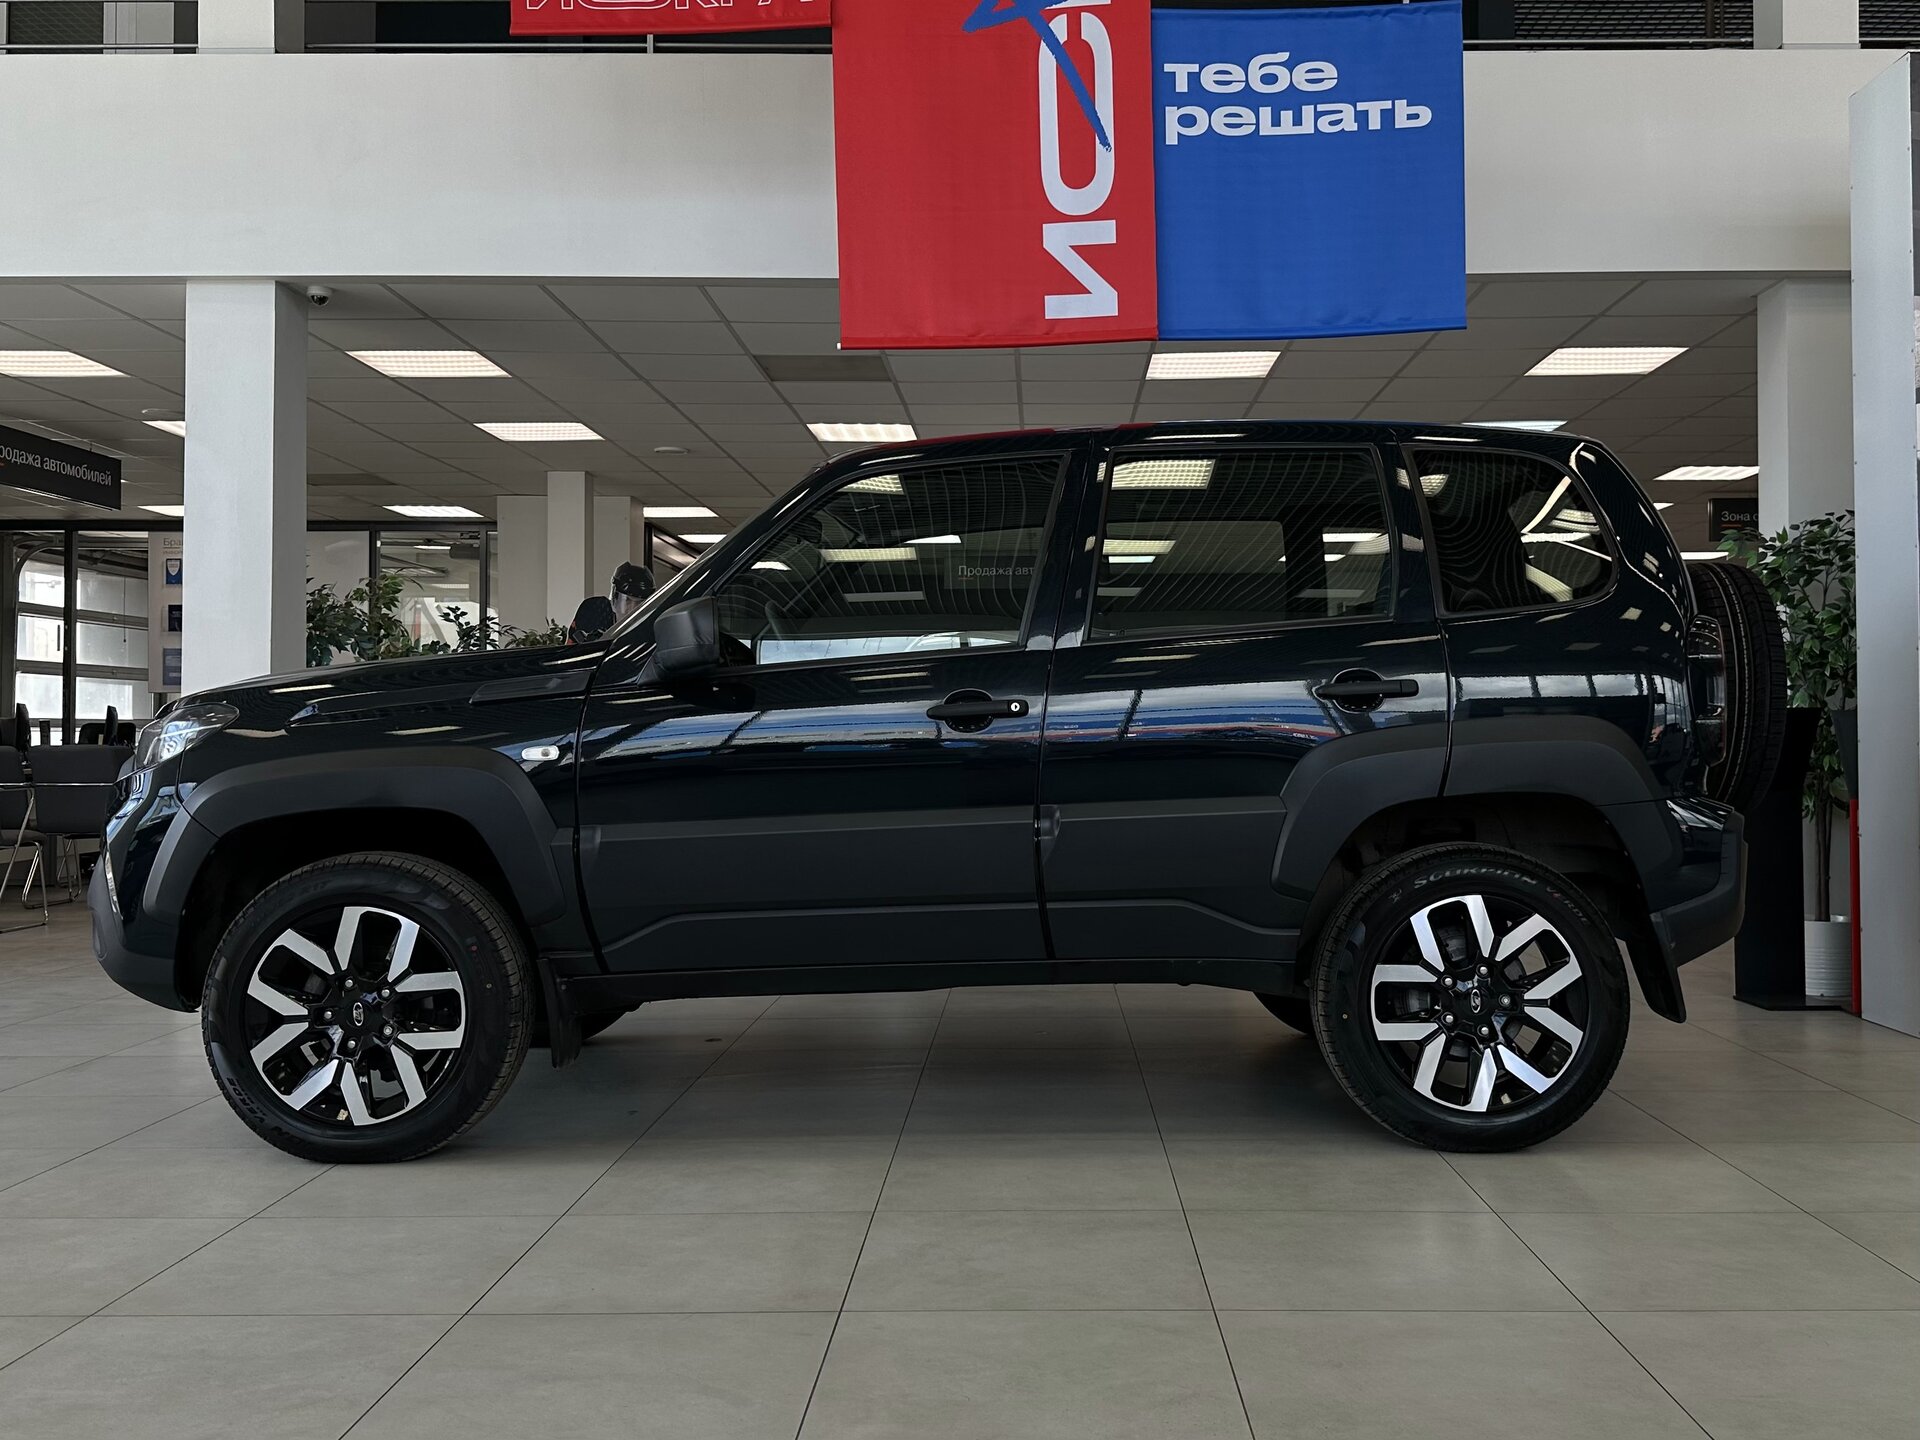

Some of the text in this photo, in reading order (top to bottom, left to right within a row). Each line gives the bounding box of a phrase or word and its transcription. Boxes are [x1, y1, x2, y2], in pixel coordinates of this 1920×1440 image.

[1163, 51, 1338, 94] тебе
[1165, 99, 1433, 146] решать
[43, 457, 112, 487] автомобилей
[1721, 510, 1751, 522] Зона
[958, 565, 1012, 577] Продажа
